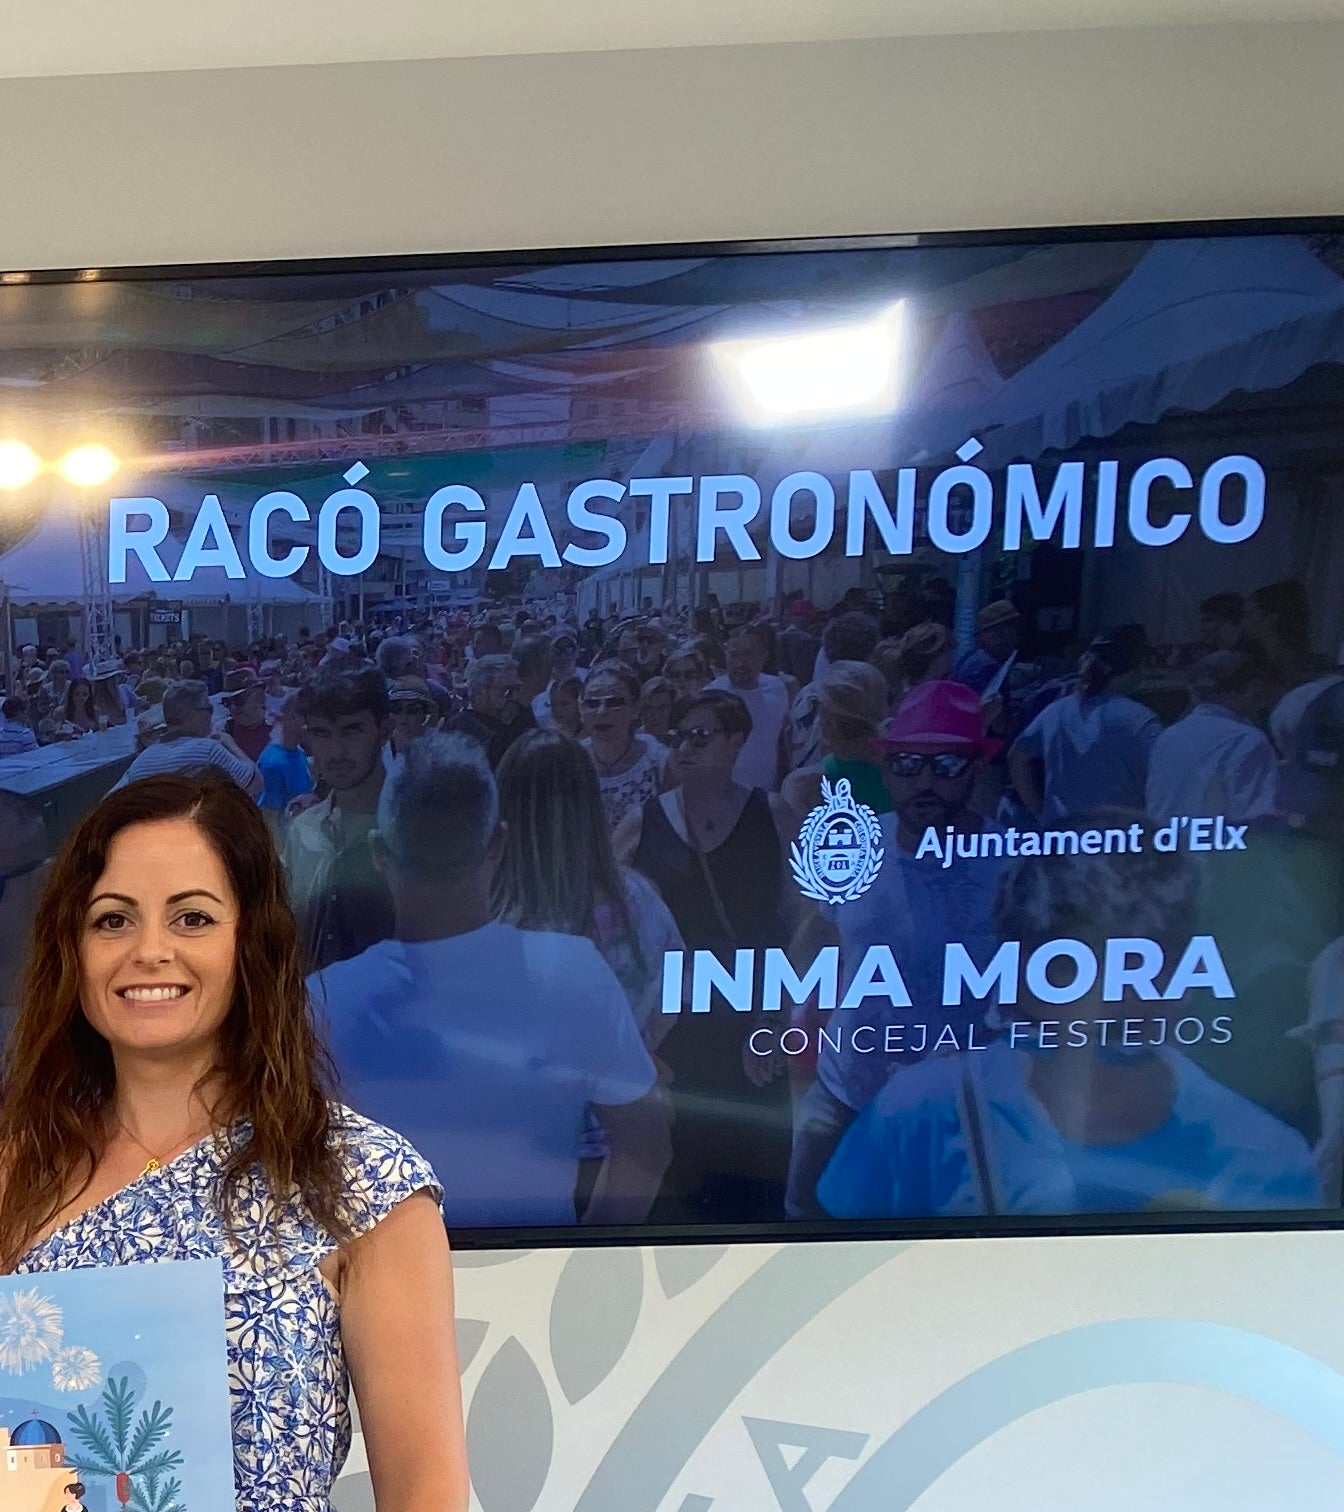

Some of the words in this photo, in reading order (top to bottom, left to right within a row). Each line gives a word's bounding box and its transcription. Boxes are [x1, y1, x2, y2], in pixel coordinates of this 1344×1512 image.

[109, 462, 380, 584] RACÓ
[423, 440, 1265, 572] GASTRONÓMICO
[915, 827, 1142, 869] Ajuntament
[1153, 816, 1248, 854] d'Elx
[661, 944, 912, 1014] INMA
[942, 935, 1235, 1006] MORA
[749, 1023, 987, 1056] CONCEJAL
[1010, 1016, 1232, 1049] FESTEJOS
